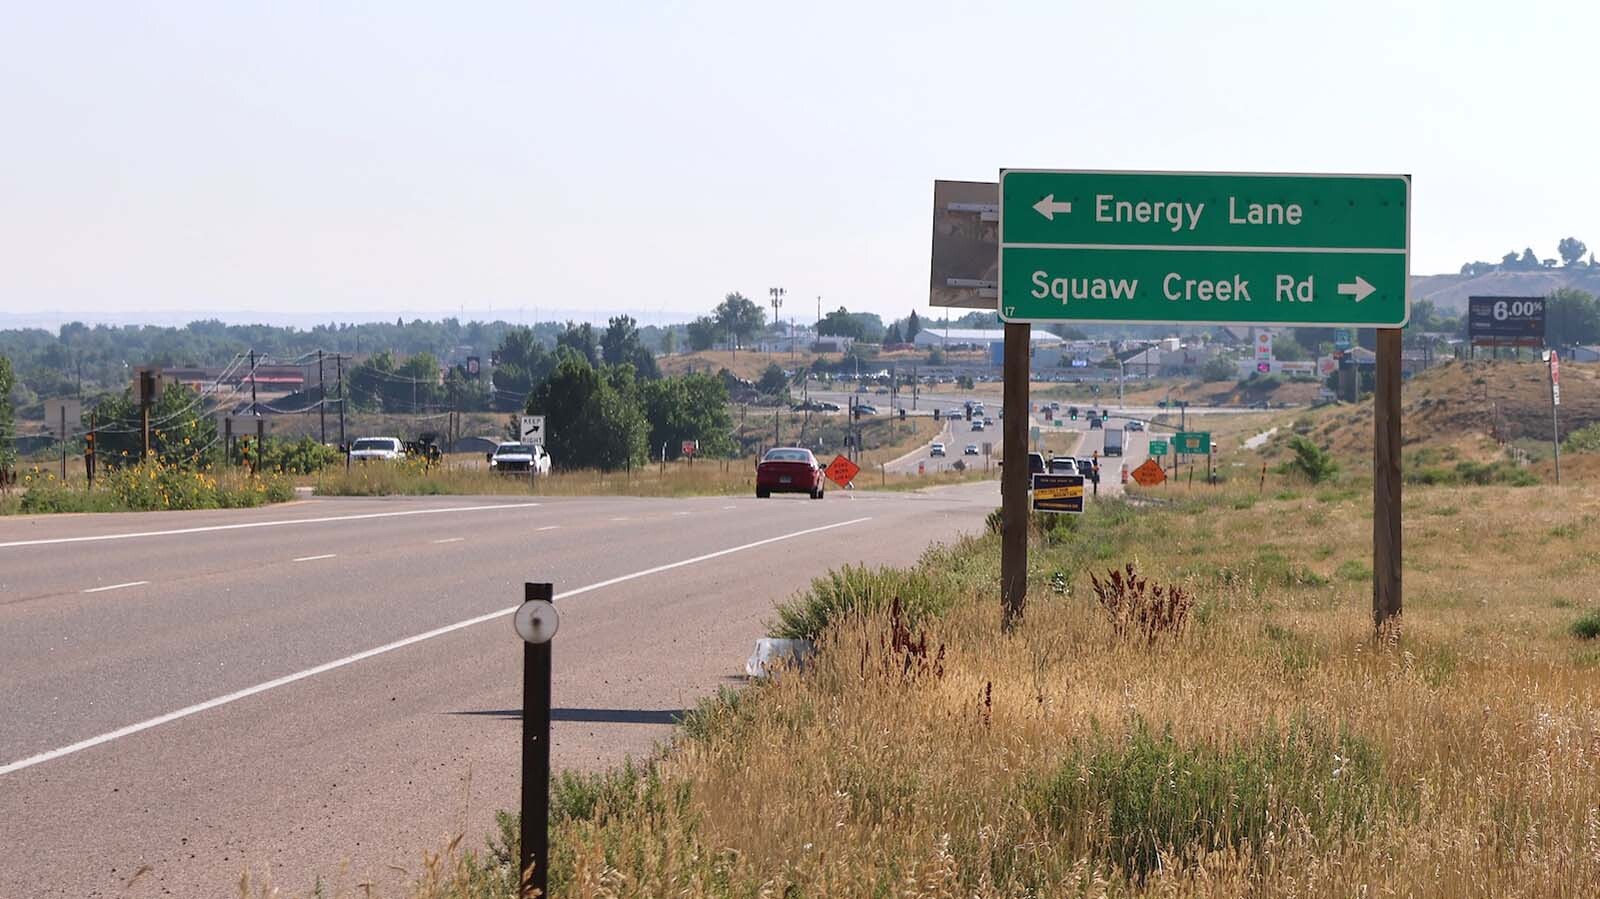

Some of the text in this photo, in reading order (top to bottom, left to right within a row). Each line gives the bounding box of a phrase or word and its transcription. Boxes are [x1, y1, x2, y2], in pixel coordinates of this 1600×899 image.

[1095, 194, 1303, 232] Energy Lane
[1031, 270, 1314, 305] Squaw Creek Rd
[1004, 306, 1015, 316] 17
[1493, 301, 1543, 320] 6.00%
